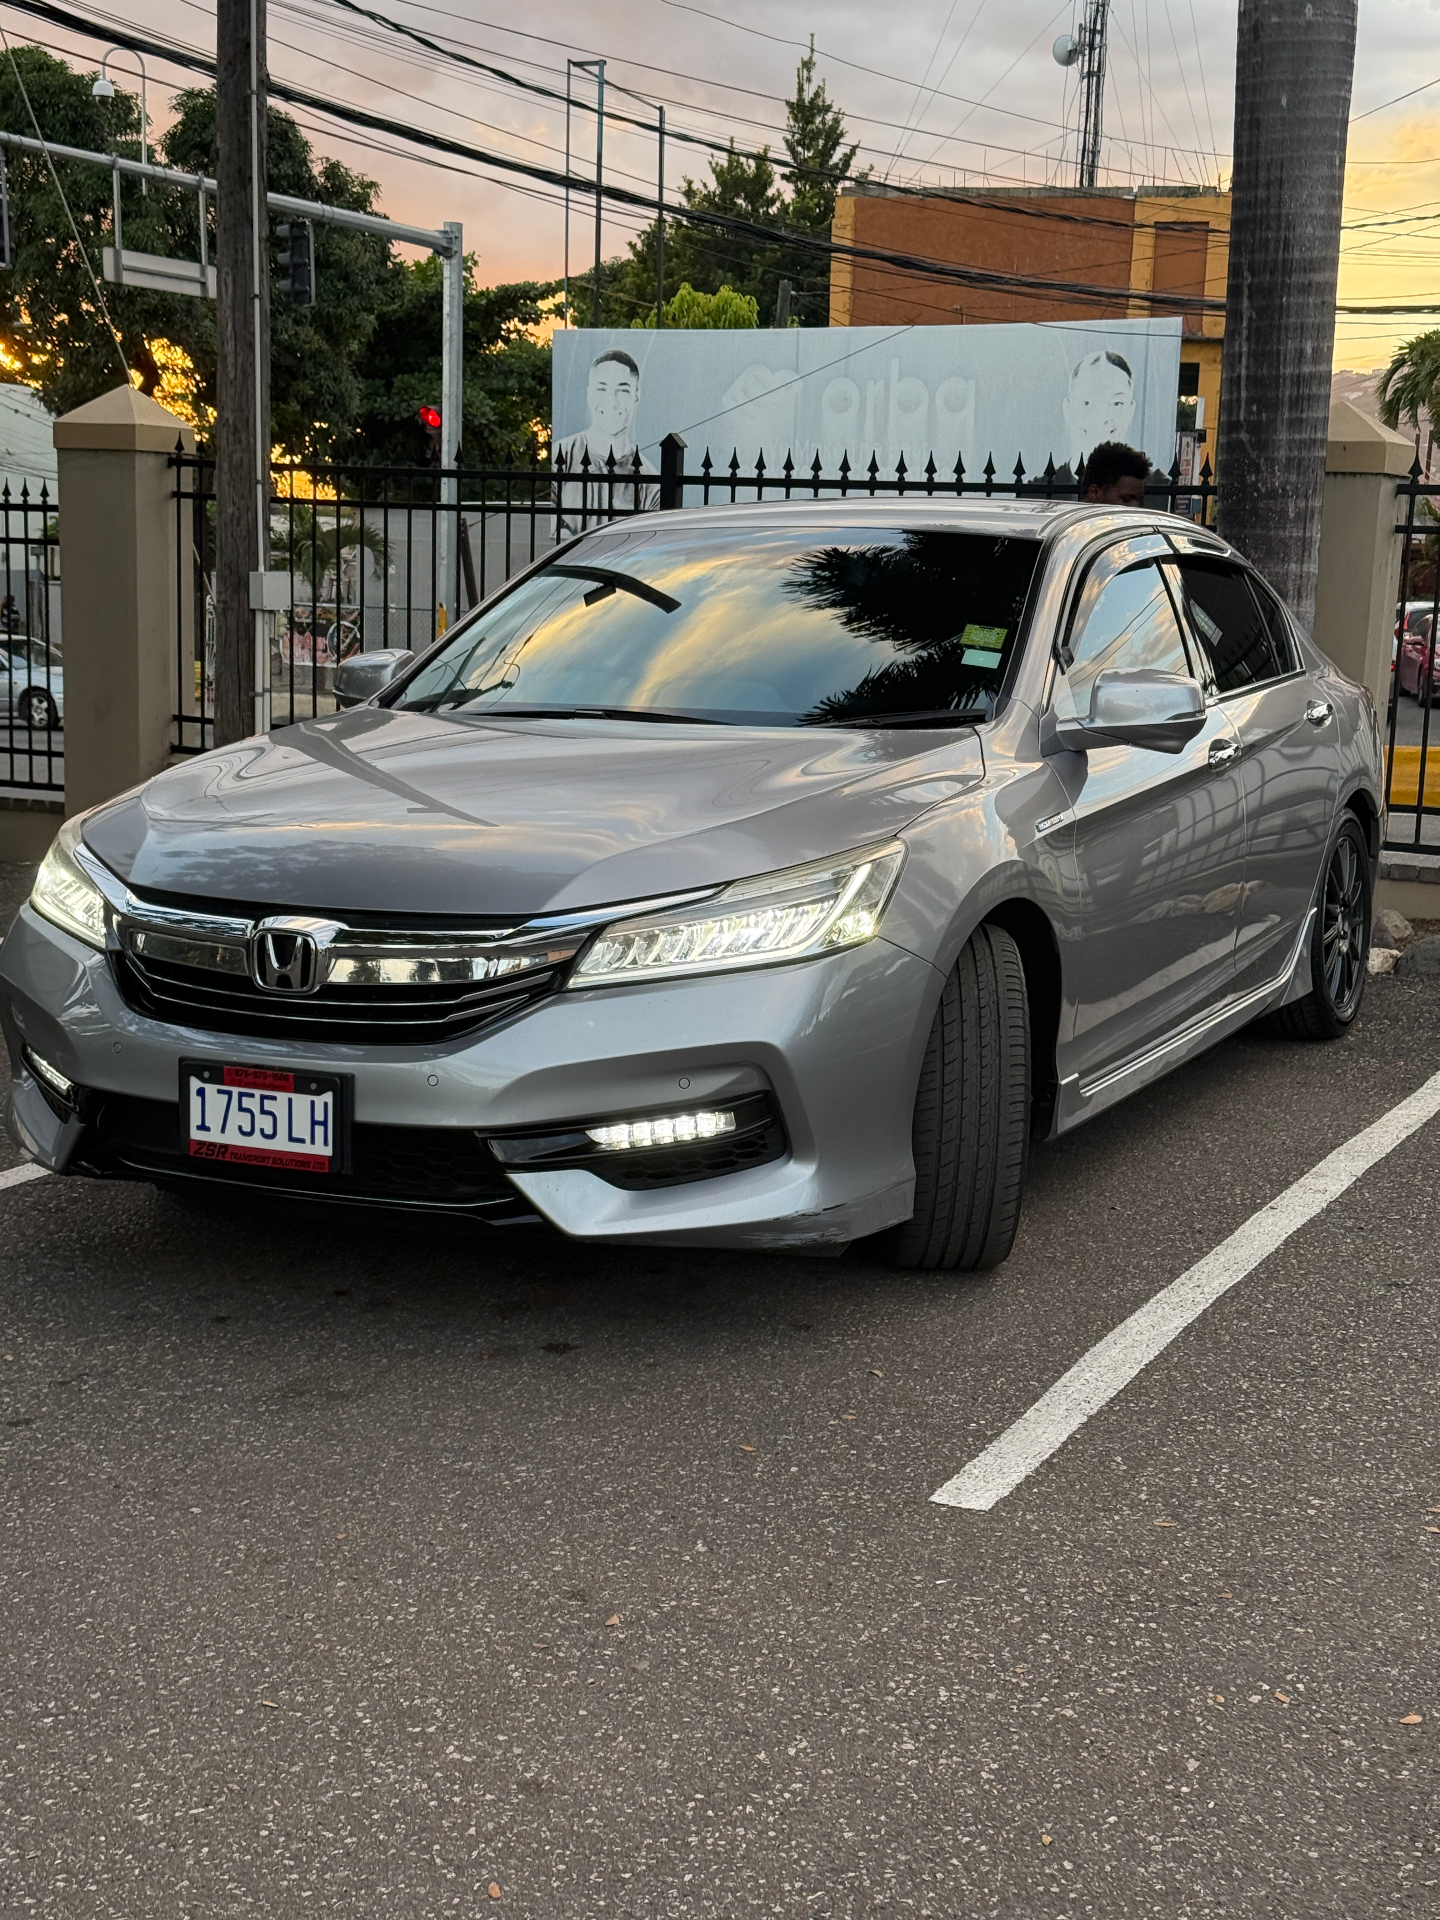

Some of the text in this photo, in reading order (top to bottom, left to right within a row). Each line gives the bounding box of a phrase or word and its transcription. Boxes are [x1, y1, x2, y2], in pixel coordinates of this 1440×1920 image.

[193, 1142, 229, 1159] ZSR
[229, 1152, 270, 1164] TRANSPORT
[271, 1156, 311, 1169] SOLUTIONS
